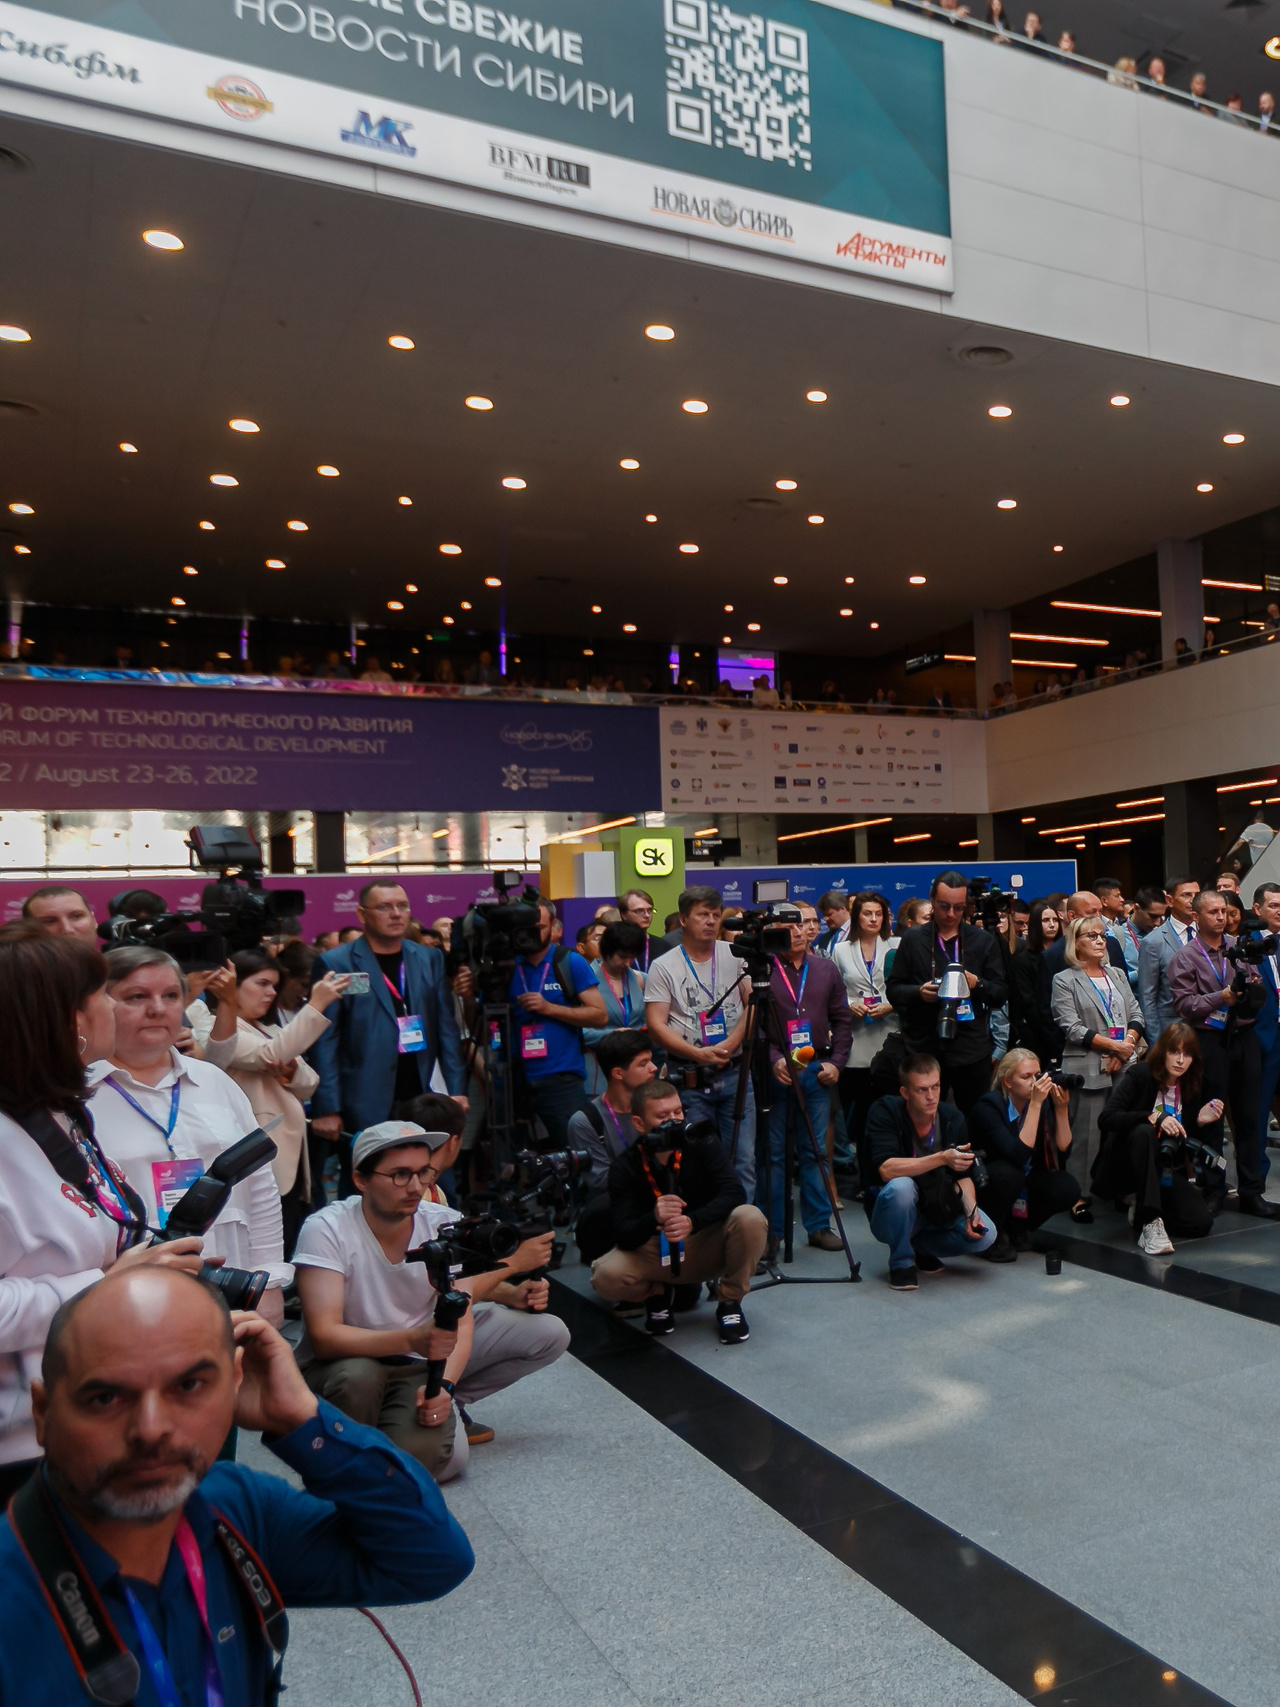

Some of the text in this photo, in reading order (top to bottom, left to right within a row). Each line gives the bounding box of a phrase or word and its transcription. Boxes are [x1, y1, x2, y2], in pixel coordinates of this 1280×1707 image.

[416, 0, 584, 65] СВЕЖИЕ
[234, 0, 635, 124] НОВОСТИ СИБИРИ
[653, 185, 794, 239] НОВАЯ СИБИРЬ
[842, 233, 946, 266] АРГУМЕНТЫ
[19, 706, 99, 723] ФОРУМ
[105, 708, 313, 731] ТЕХНОЛОГИЧЕСКОГО
[317, 715, 414, 734] РАЗВИТИЯ
[55, 731, 82, 746] OF
[90, 732, 249, 752] TECHNOLOGICAL
[254, 736, 388, 754] DEVELOPMENT
[35, 763, 120, 788] August
[127, 764, 199, 786] 23-26,
[205, 765, 258, 785] 2022
[642, 848, 666, 866] Sk
[242, 1561, 272, 1607] EOS
[56, 1571, 101, 1648] Canon
